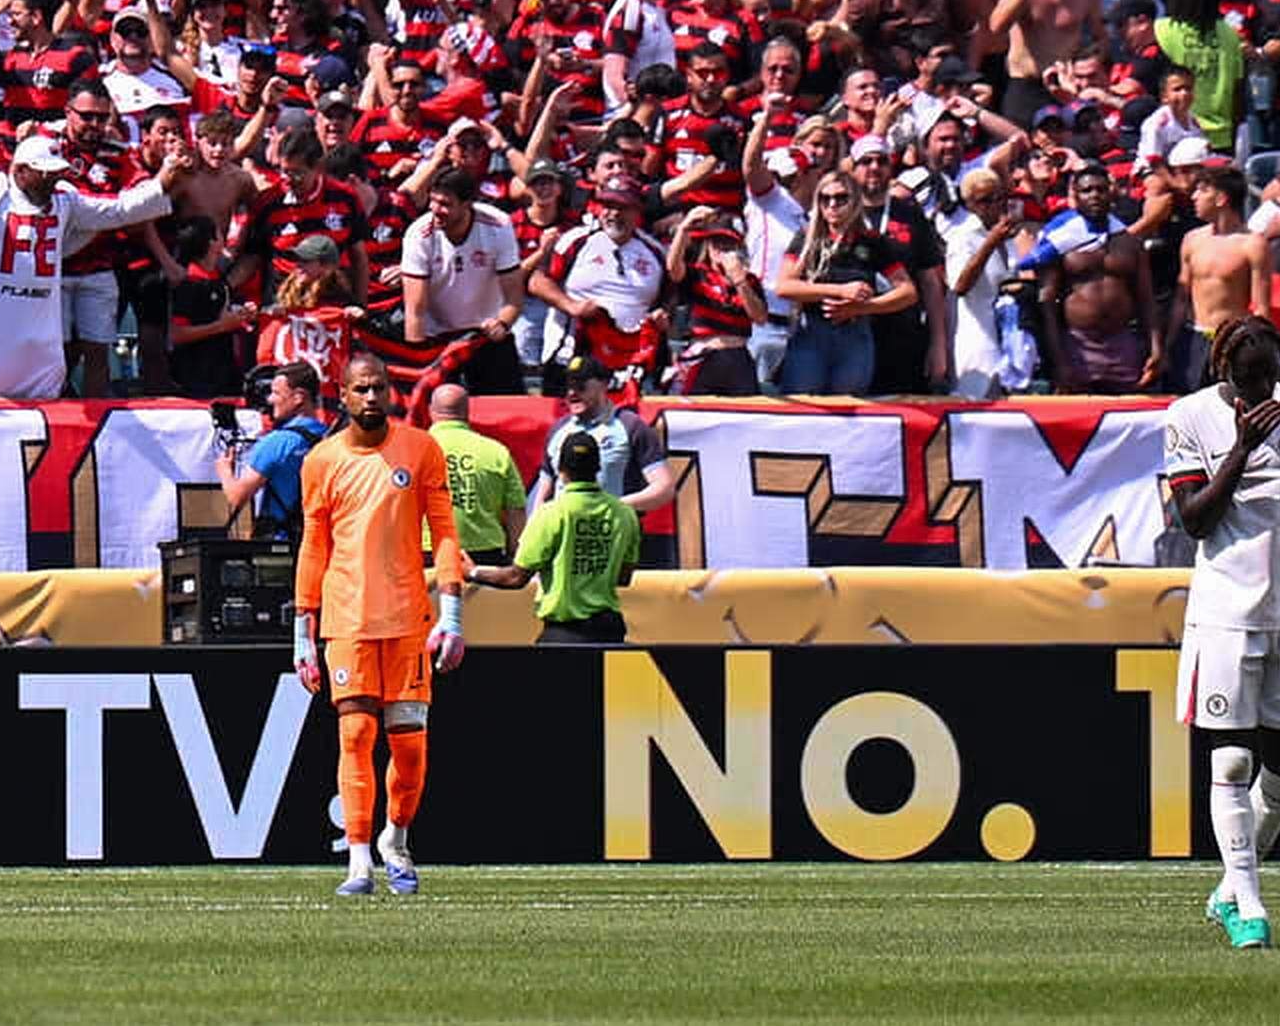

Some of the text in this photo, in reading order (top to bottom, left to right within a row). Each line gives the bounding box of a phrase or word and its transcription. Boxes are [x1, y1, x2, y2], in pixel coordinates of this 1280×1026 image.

[447, 454, 475, 472] SC
[576, 519, 612, 536] CSC
[604, 650, 1037, 863] No.
[1116, 651, 1192, 859] 1
